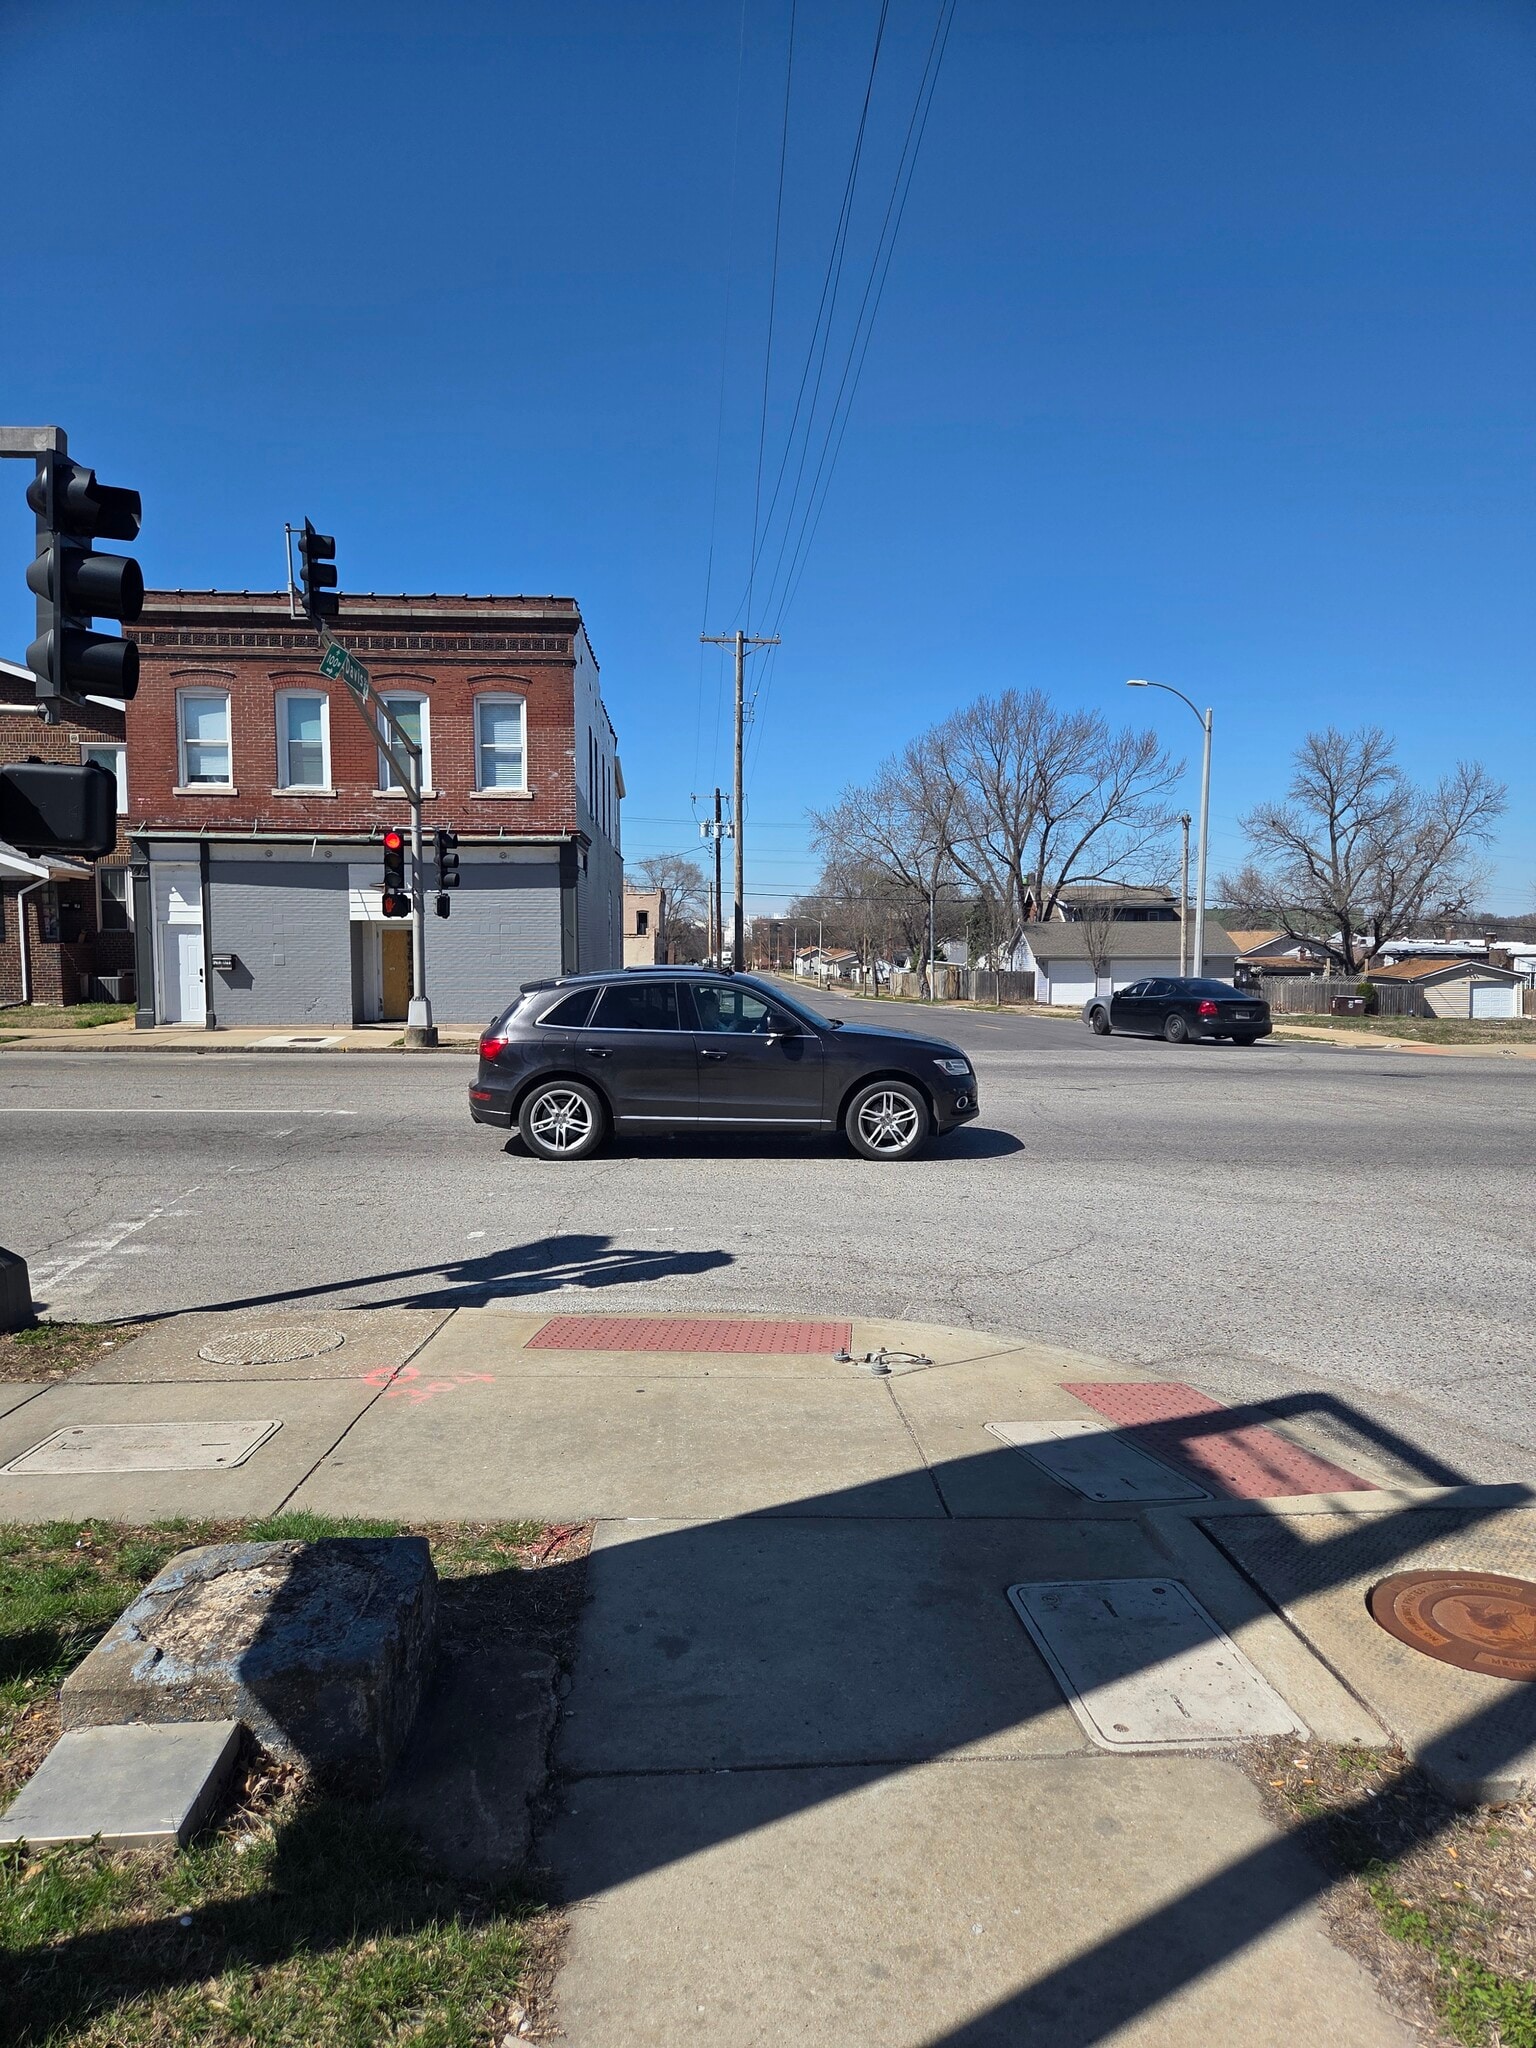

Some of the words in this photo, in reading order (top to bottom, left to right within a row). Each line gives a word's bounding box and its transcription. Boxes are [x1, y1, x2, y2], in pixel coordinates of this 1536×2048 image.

[345, 657, 363, 687] Davis
[1403, 1586, 1428, 1605] PROTECT
[1491, 1658, 1536, 1669] METRO
